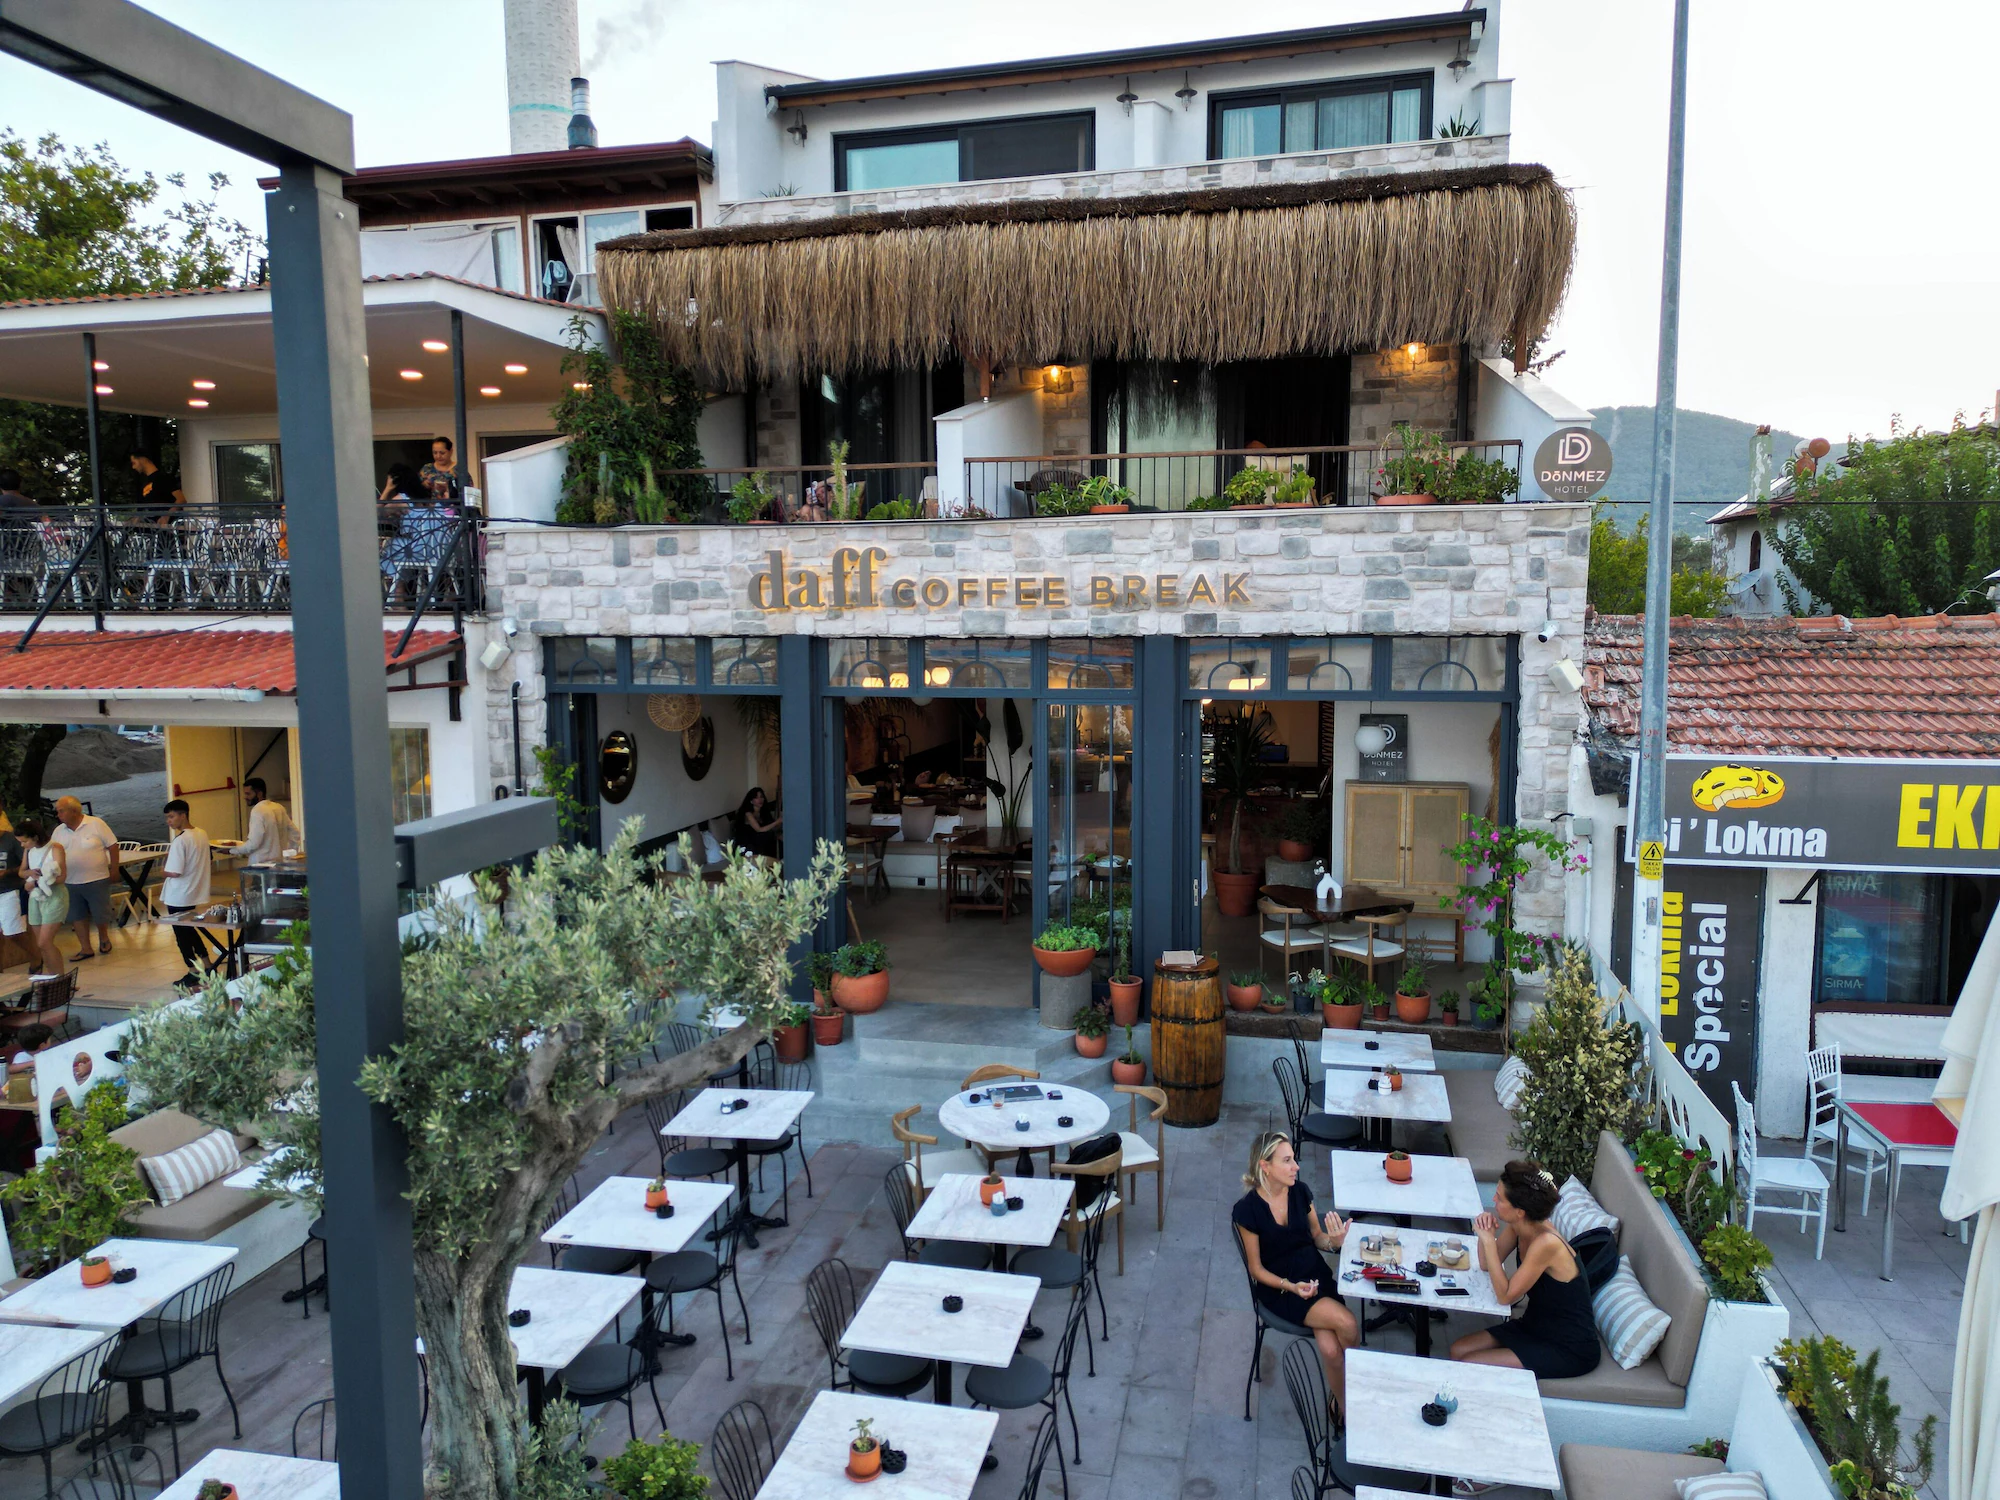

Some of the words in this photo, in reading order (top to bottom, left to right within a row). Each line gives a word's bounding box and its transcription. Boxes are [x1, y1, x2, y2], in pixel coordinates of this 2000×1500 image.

[1554, 485, 1589, 494] HOTEL
[747, 546, 887, 609] daff
[891, 577, 1066, 607] COFFEE
[1090, 572, 1251, 605] BREAK
[1704, 818, 1828, 858] Lokma
[1683, 902, 1731, 1072] Special
[1824, 977, 1864, 989] SIRMA
